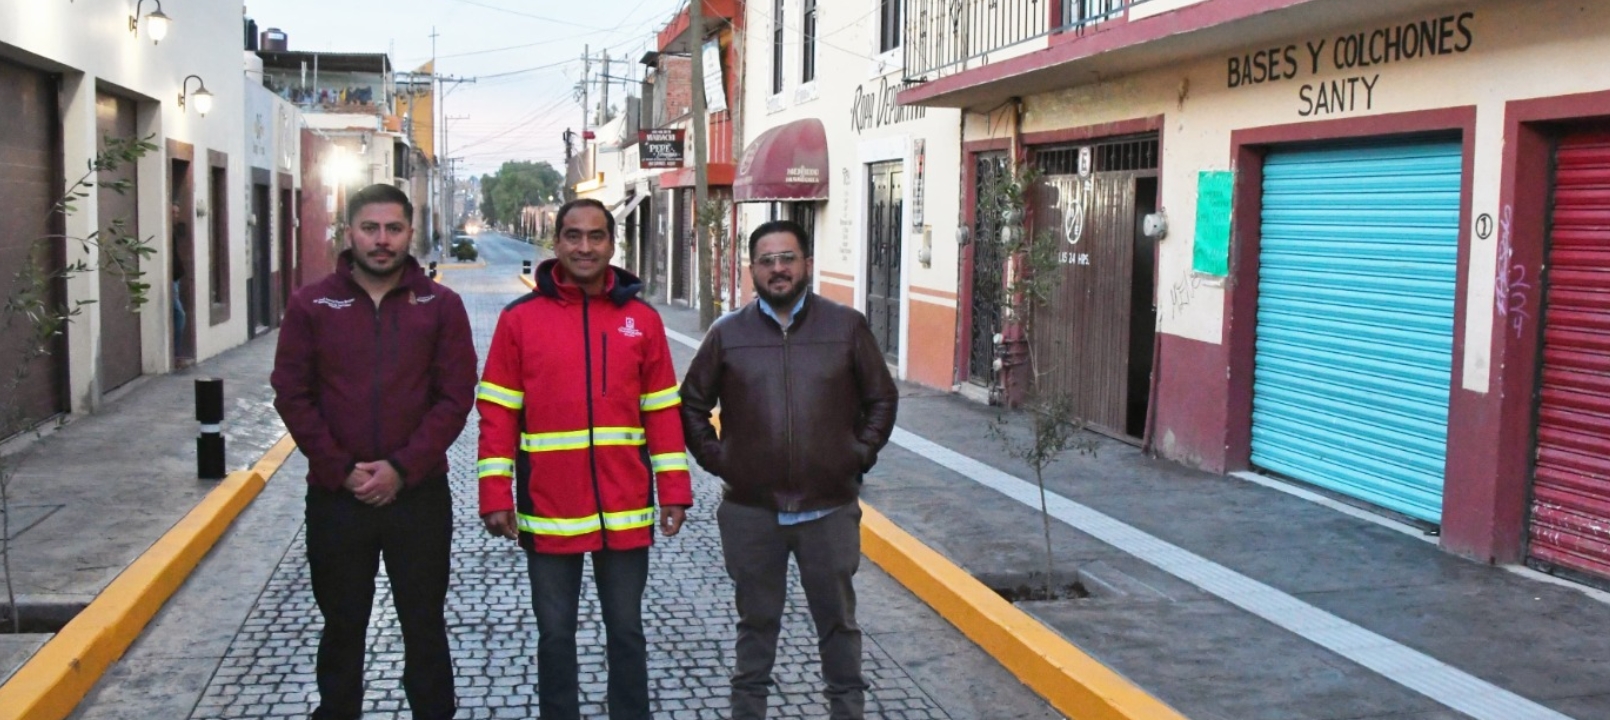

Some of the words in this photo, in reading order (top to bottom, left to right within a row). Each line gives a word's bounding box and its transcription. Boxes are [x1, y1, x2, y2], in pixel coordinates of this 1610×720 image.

[1227, 44, 1298, 88] BASES
[1306, 39, 1326, 75] Y
[1333, 12, 1474, 69] COLCHONES
[850, 84, 875, 135] ROPA
[1298, 74, 1380, 117] SANTY
